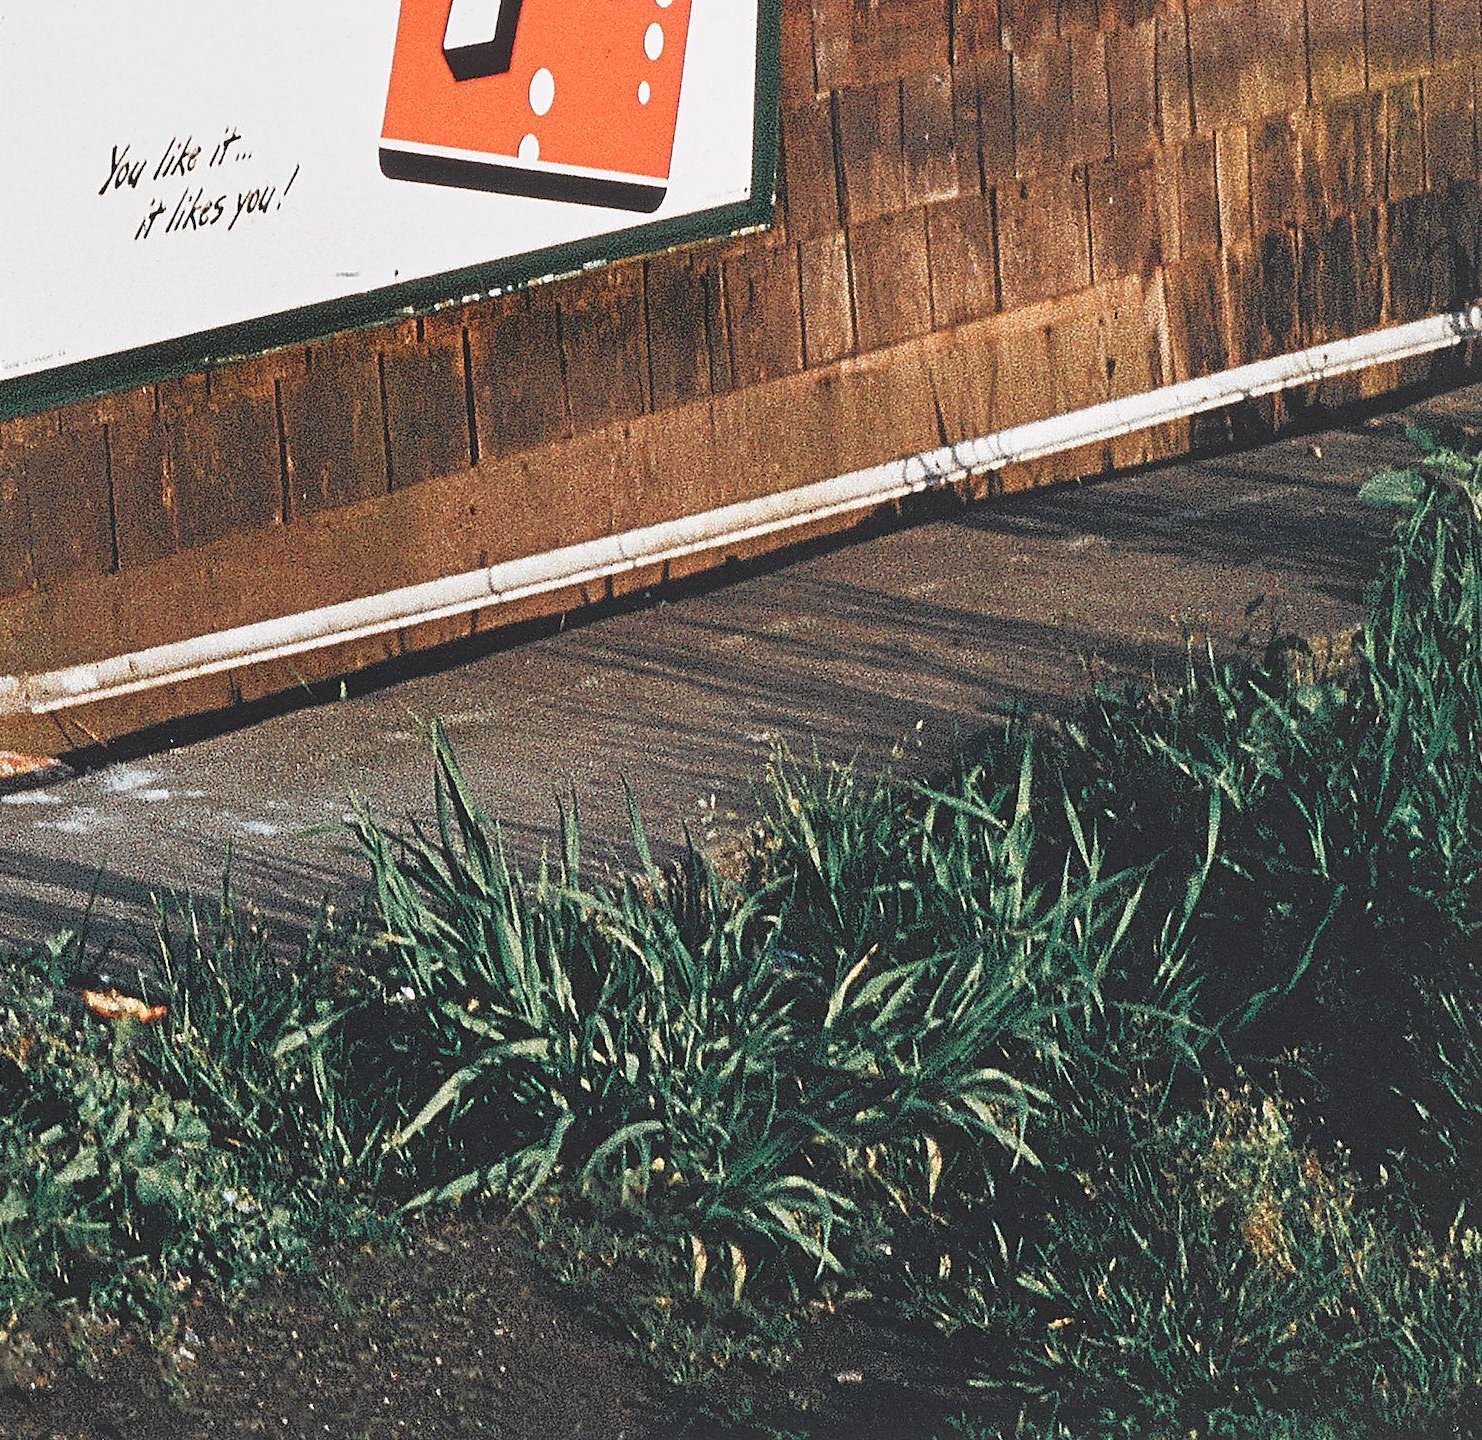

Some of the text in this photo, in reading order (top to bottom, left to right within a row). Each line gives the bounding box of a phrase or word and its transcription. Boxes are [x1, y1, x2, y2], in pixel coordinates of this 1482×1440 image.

[98, 144, 148, 196] You
[153, 136, 202, 181] like
[134, 163, 300, 241] it likes you!
